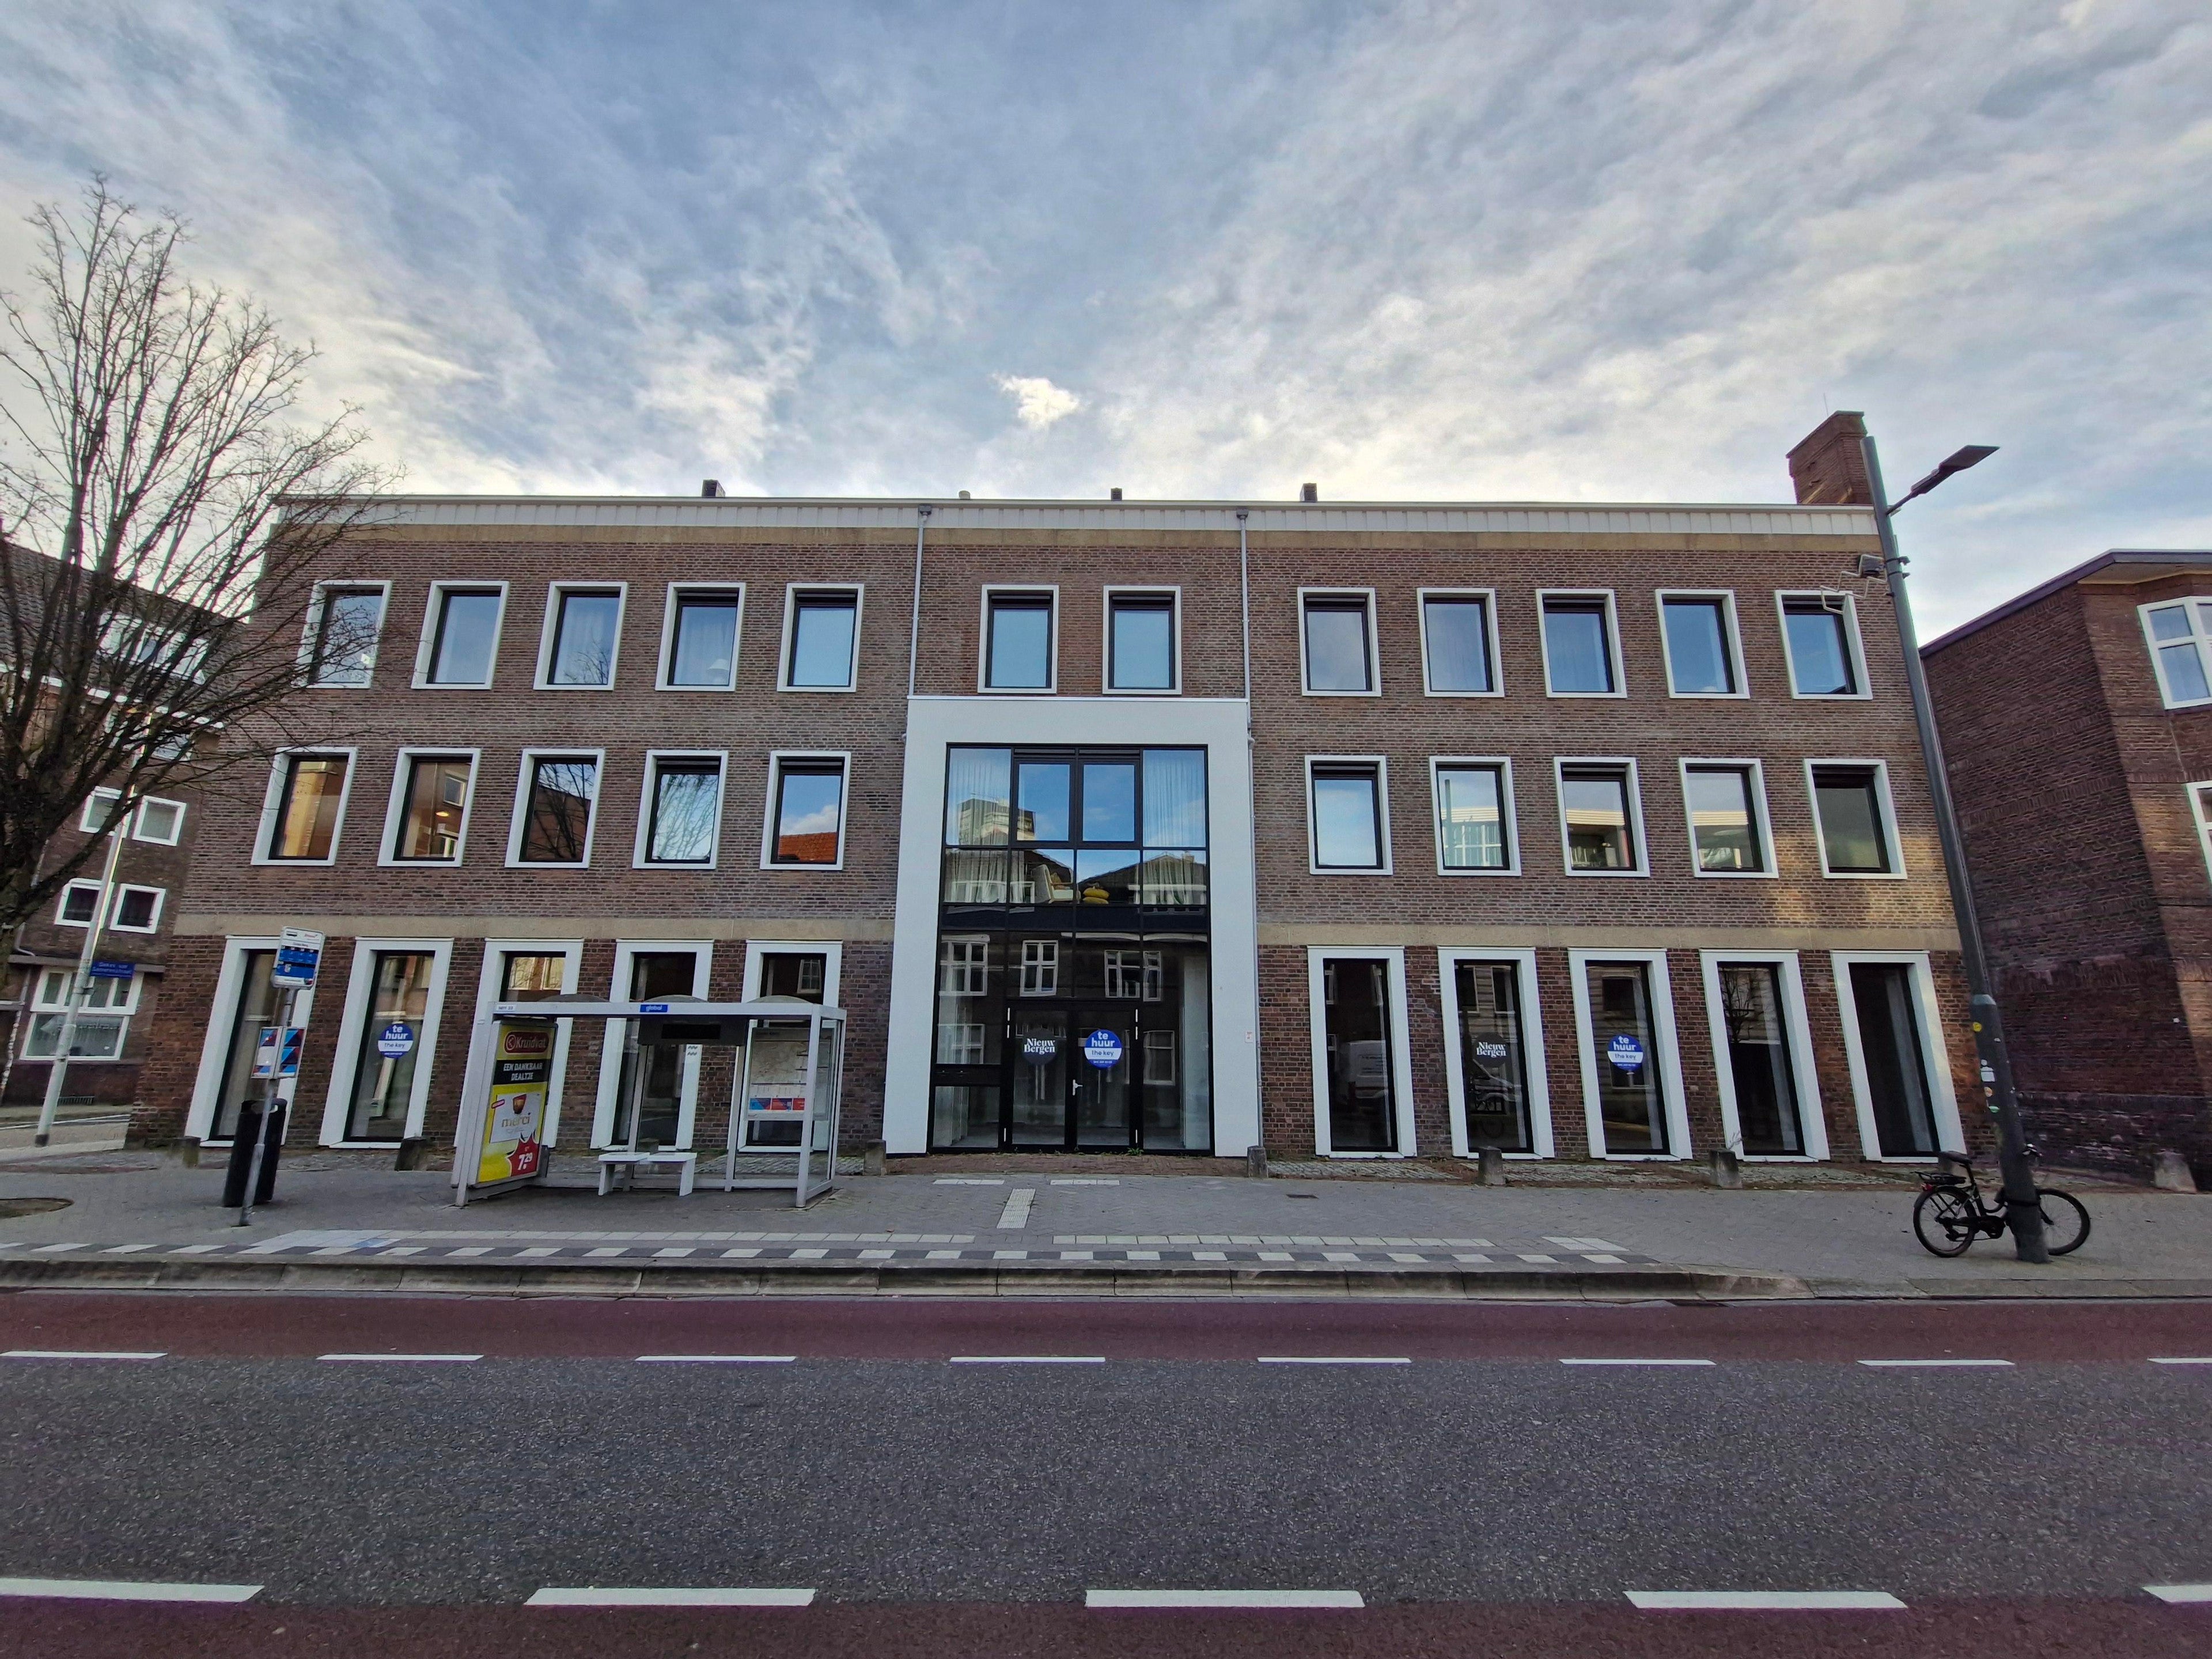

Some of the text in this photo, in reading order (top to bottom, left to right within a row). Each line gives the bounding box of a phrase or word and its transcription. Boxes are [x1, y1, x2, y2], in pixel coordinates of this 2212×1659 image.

[392, 1025, 403, 1033] te
[385, 1031, 408, 1040] huur
[1097, 1031, 1108, 1040] te
[1618, 1036, 1630, 1044] te
[515, 1036, 547, 1048] Kruidvat
[1027, 1038, 1055, 1047] Nieuw
[1091, 1037, 1115, 1047] huur
[1478, 1041, 1506, 1050] Nieuw
[1613, 1041, 1637, 1051] huur
[1024, 1044, 1055, 1055] Bergen
[1476, 1047, 1507, 1058] Bergen
[503, 1062, 543, 1071] EEN DANKBAAR
[510, 1072, 534, 1081] DEALTJE
[501, 1116, 530, 1127] merci
